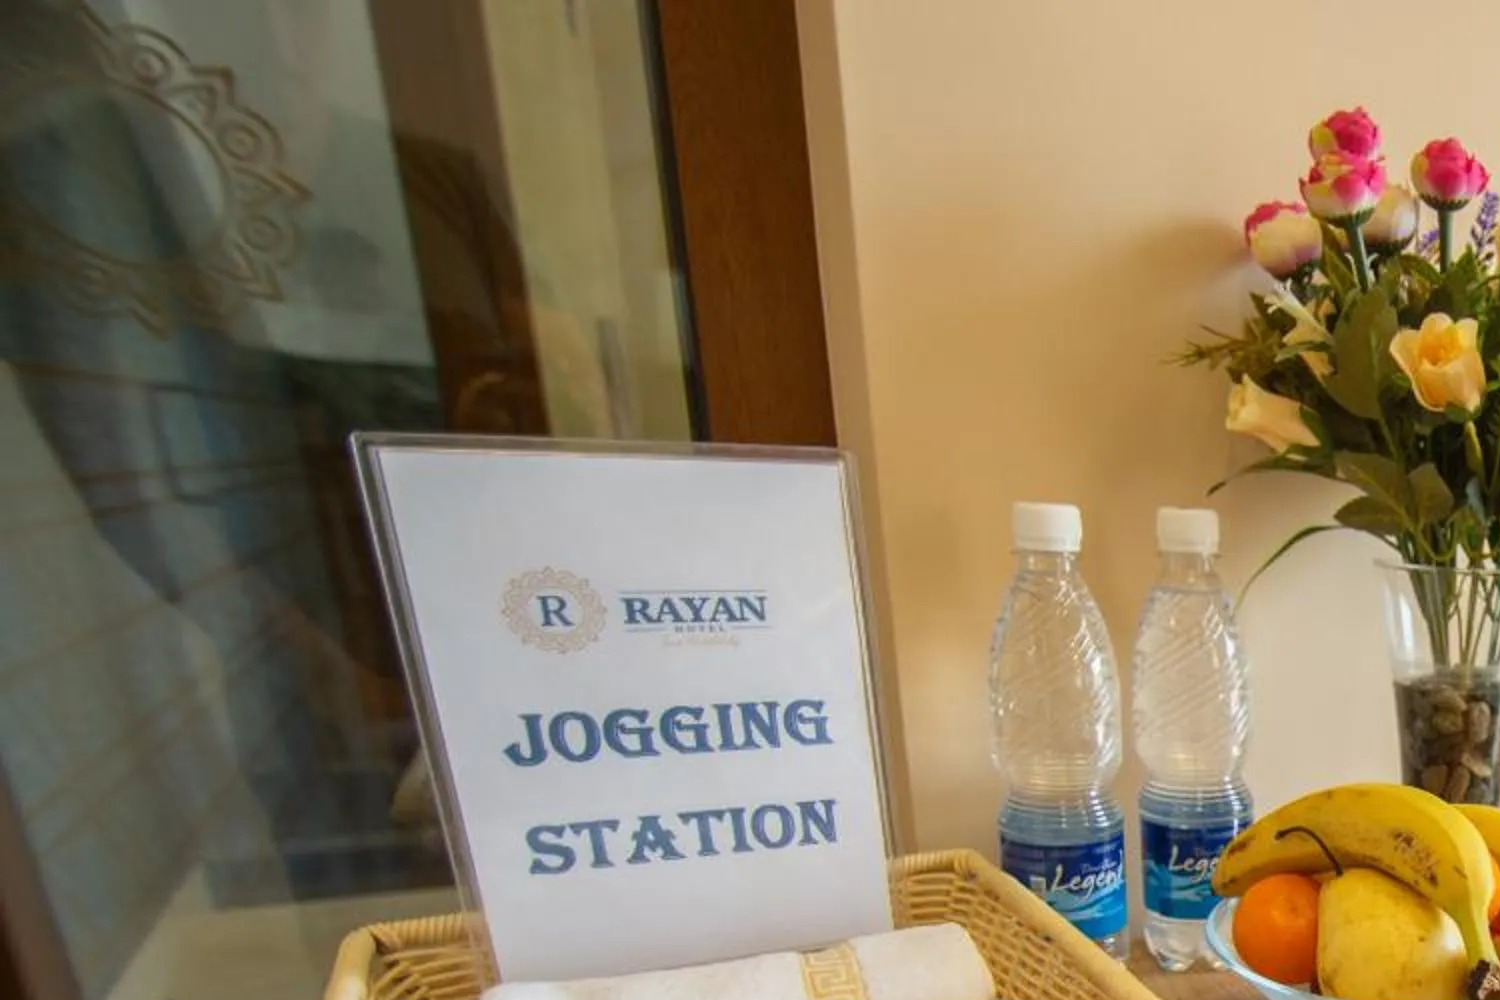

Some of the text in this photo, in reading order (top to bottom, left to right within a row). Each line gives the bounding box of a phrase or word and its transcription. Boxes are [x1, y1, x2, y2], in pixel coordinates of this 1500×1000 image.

[537, 594, 574, 627] R
[621, 596, 768, 624] RAYAN
[503, 699, 834, 767] JOGGING
[525, 798, 838, 876] STATION
[1167, 844, 1220, 884] Lege
